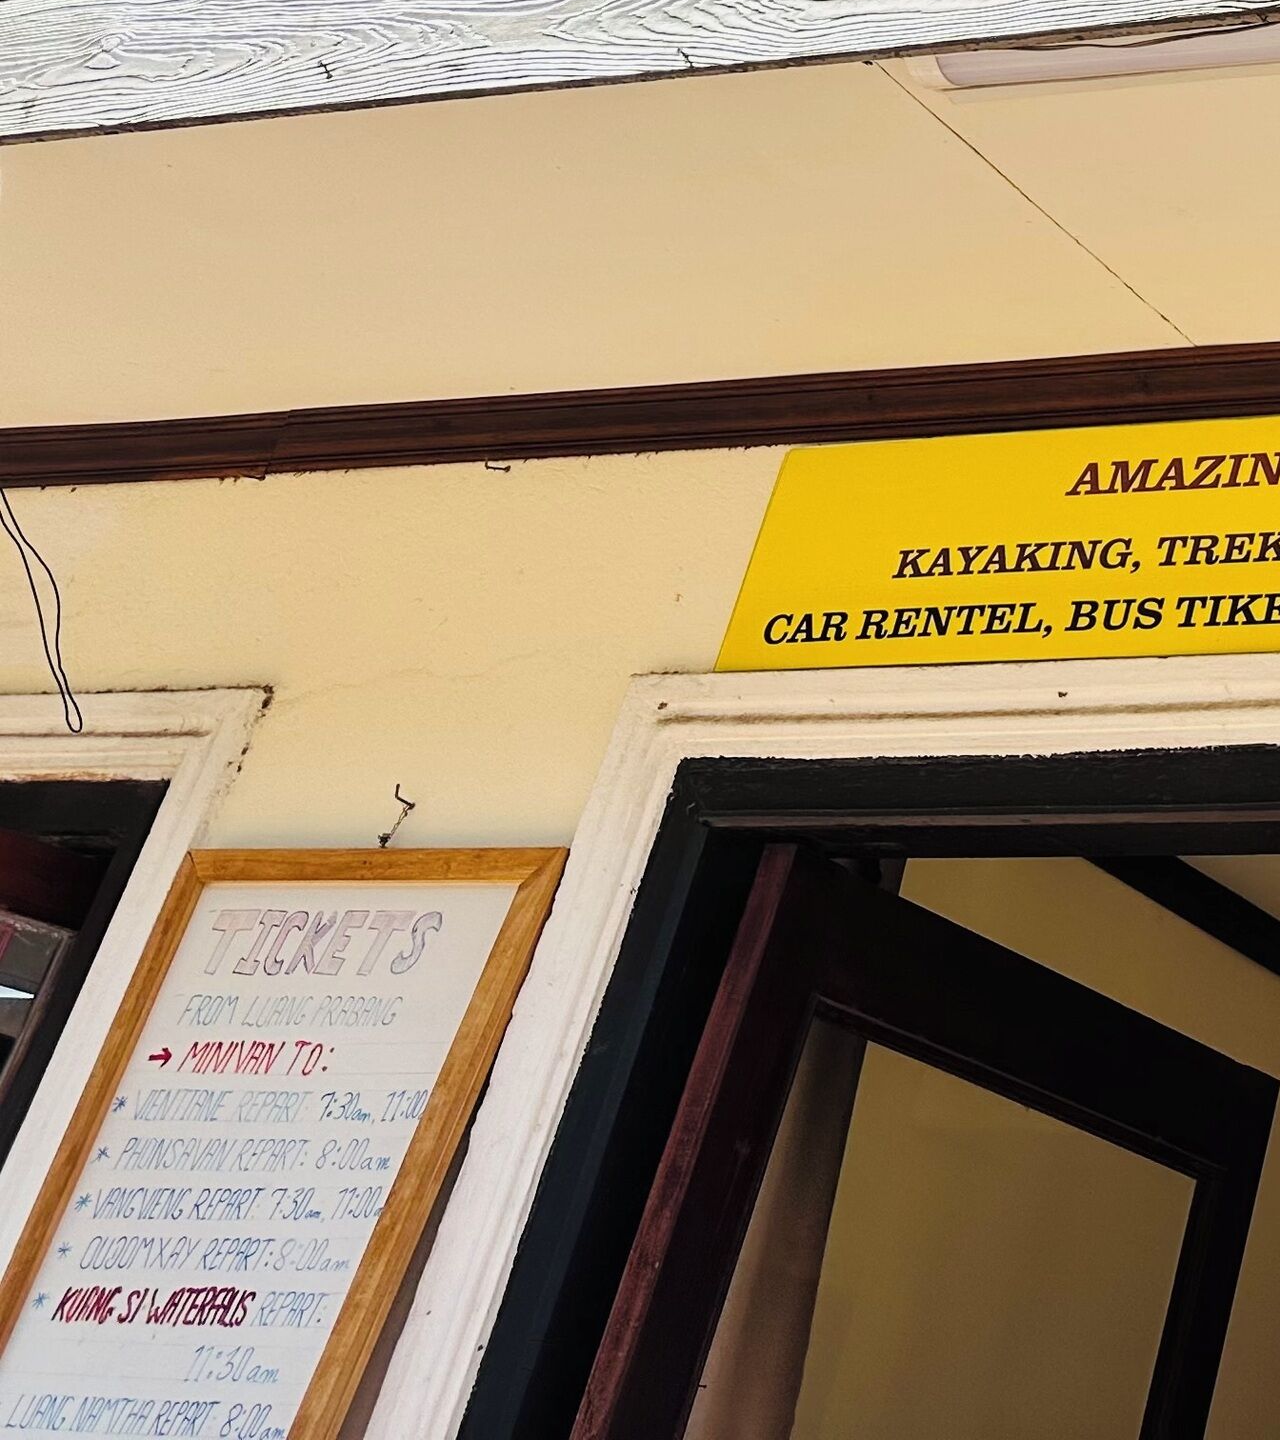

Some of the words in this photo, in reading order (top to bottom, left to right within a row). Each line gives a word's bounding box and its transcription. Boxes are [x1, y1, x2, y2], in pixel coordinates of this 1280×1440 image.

[892, 538, 1140, 578] KAYAKING,
[764, 612, 848, 644] CAR
[855, 603, 1052, 640] RENTEL,
[1064, 597, 1165, 631] BUS
[203, 909, 442, 977] TICKETS
[176, 993, 240, 1027] FROM
[241, 994, 313, 1028] LUANG
[308, 994, 403, 1028] PRABANG
[177, 1040, 286, 1076] MINIVAN
[286, 1040, 335, 1077] TO:
[315, 1138, 391, 1171] 8:00am
[273, 1238, 351, 1272] 8:00am
[51, 1285, 123, 1325] KUANG
[4, 1393, 75, 1431] LUANG
[69, 1396, 156, 1435] NAMTHA
